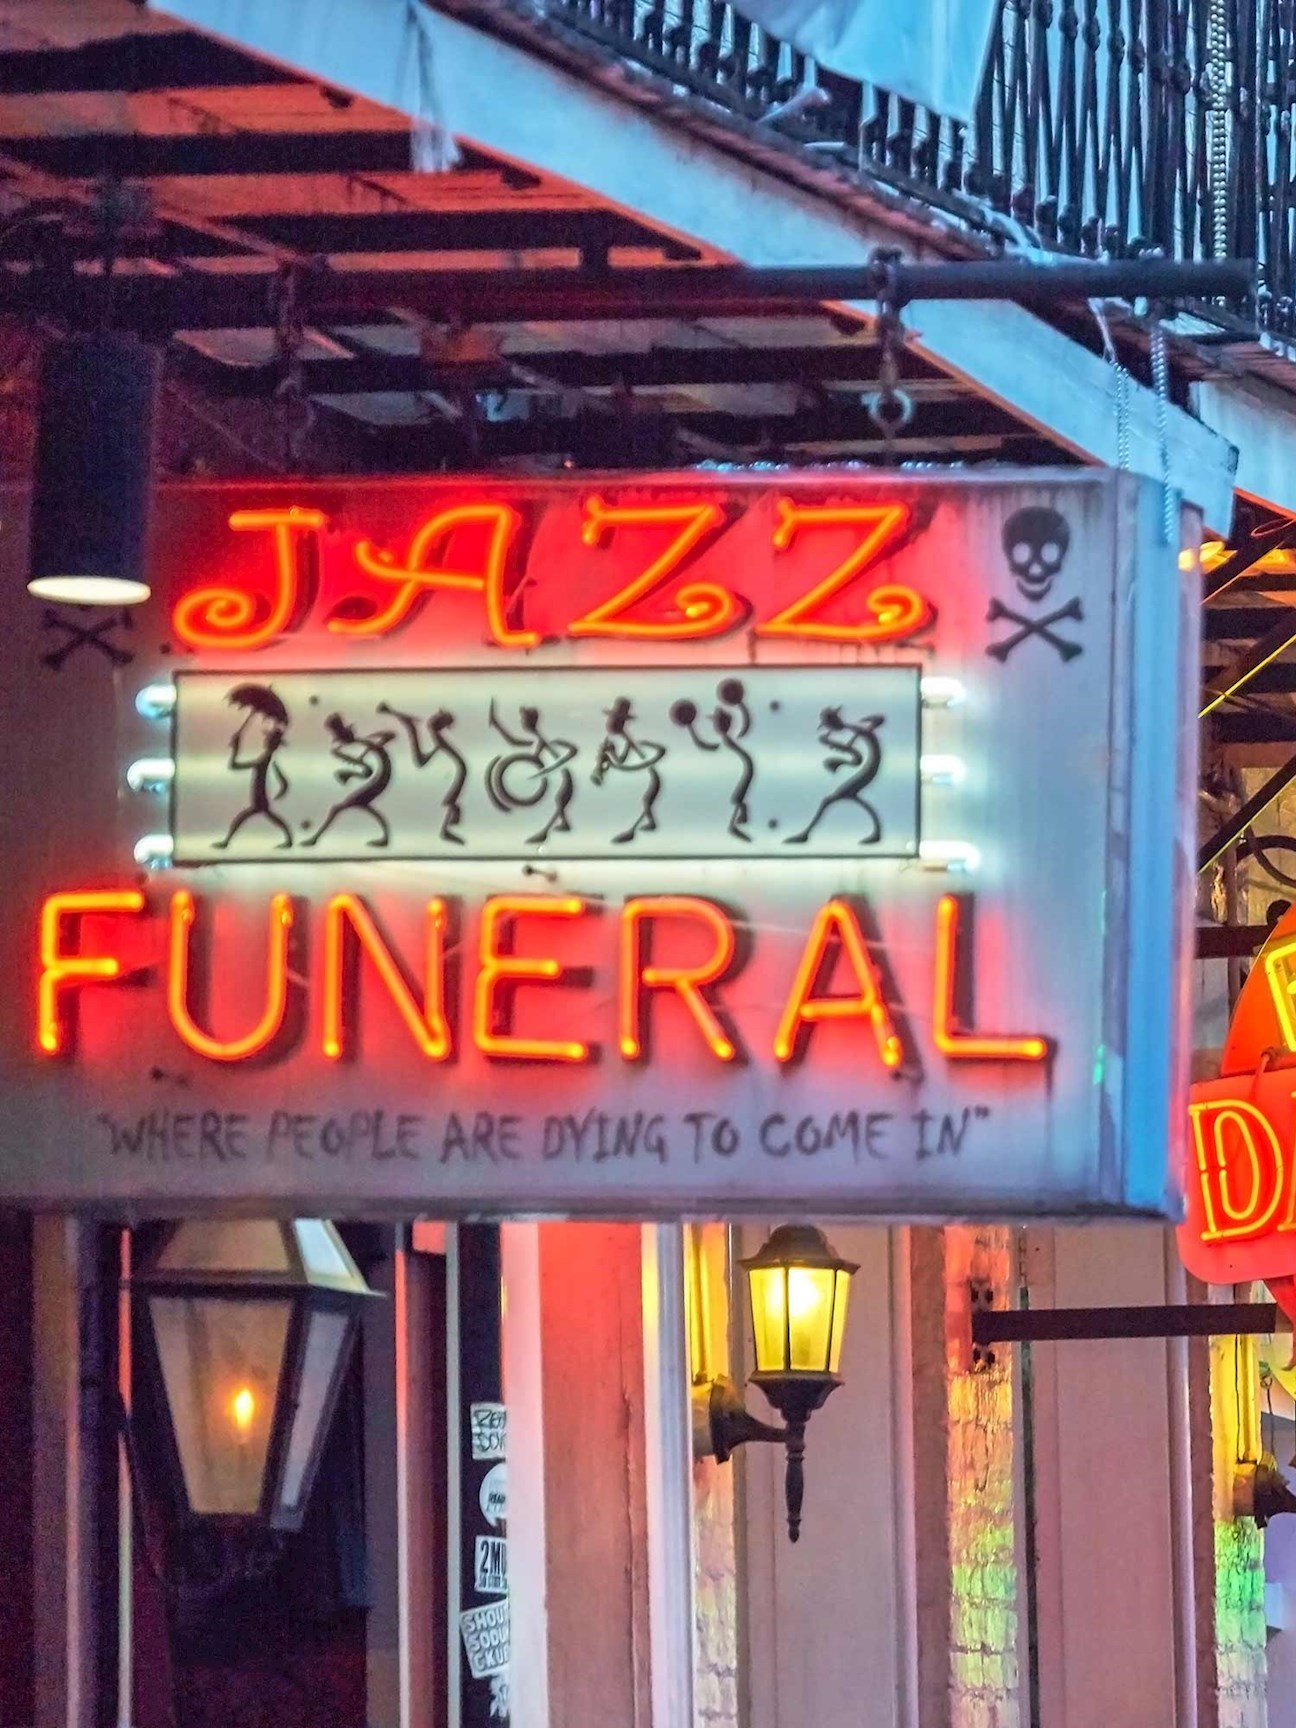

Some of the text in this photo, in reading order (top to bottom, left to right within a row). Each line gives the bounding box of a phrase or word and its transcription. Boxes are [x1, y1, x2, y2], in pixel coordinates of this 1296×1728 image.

[172, 497, 932, 650] JAZZ
[38, 889, 1048, 1067] FUNERAL
[266, 1108, 424, 1164] PEOPLE
[439, 1110, 523, 1164] ARE
[542, 1106, 668, 1165] DYING
[683, 1110, 740, 1163] TO
[758, 1110, 894, 1160] COME
